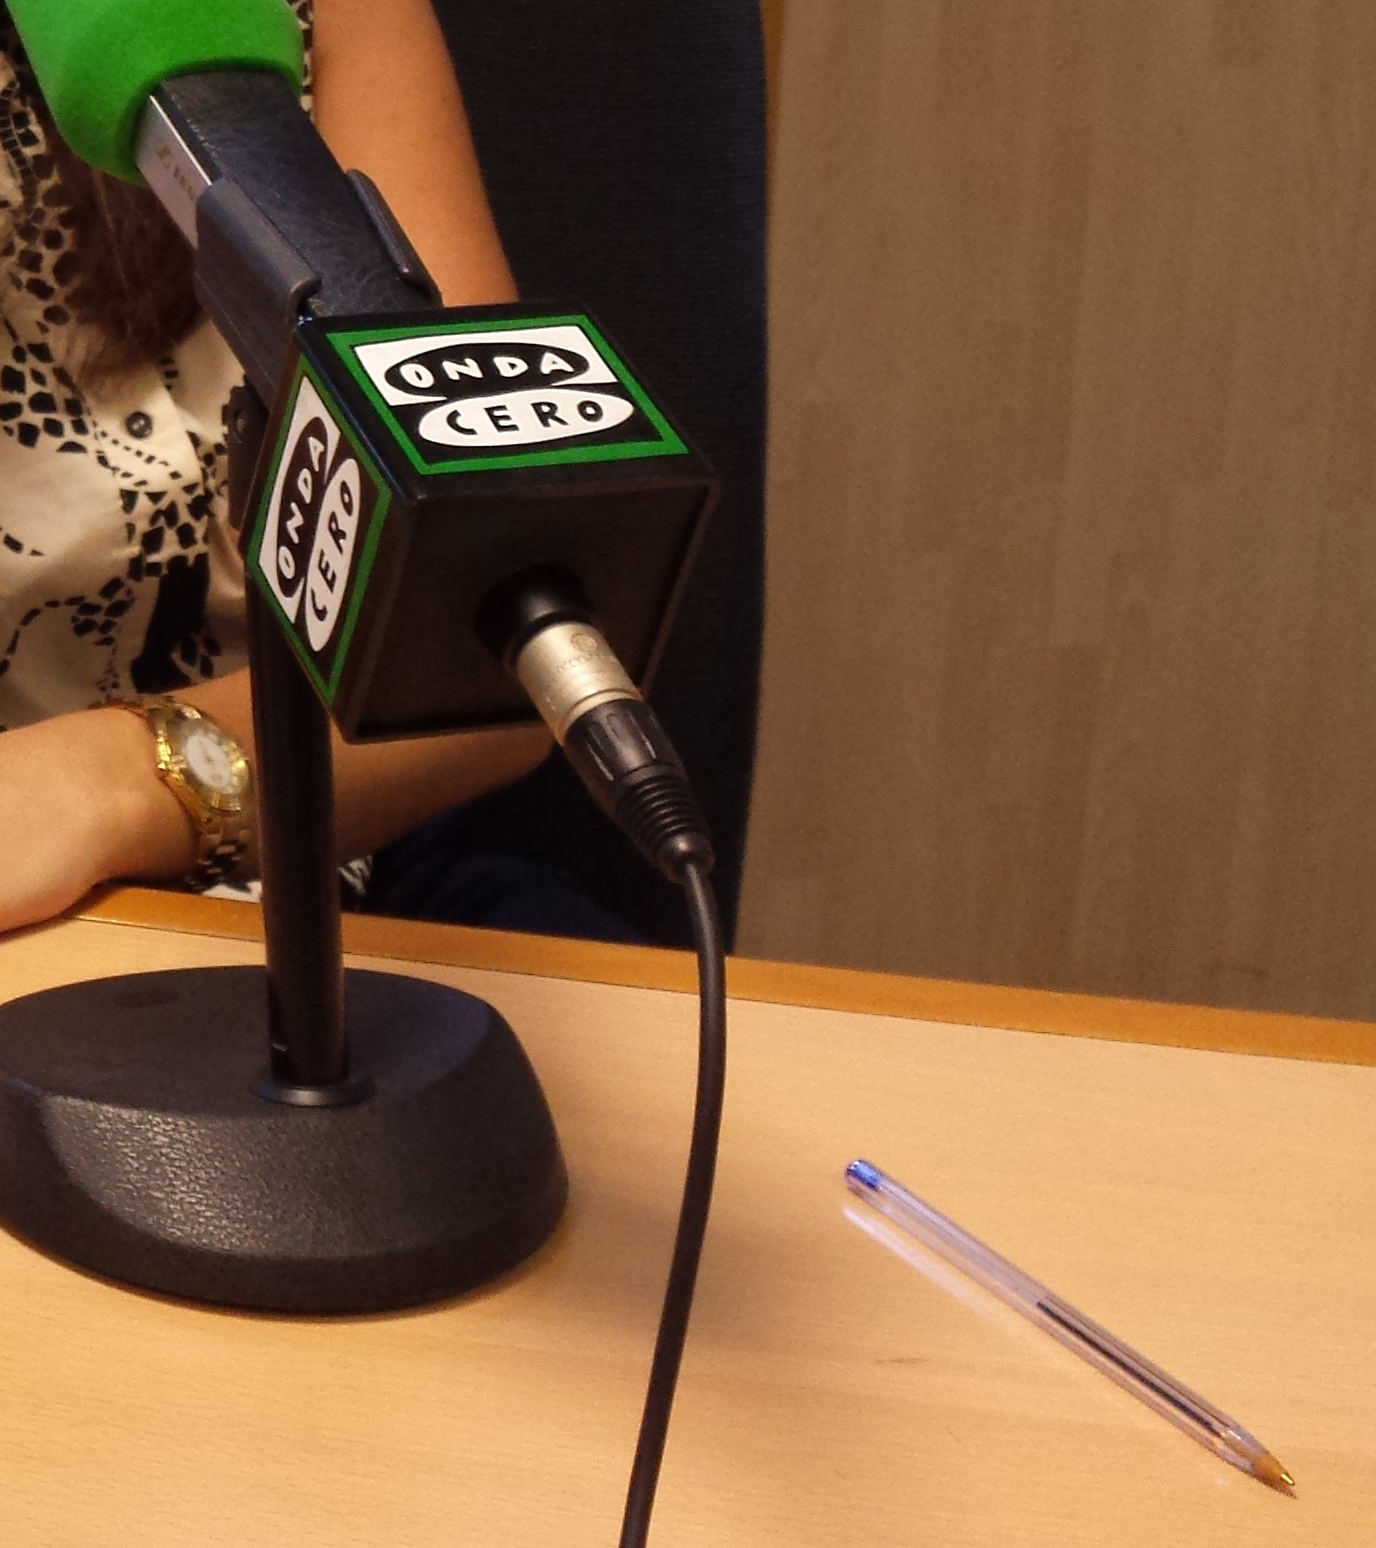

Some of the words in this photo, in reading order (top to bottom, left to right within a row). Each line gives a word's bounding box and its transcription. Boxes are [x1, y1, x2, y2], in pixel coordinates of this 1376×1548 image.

[400, 352, 574, 388] ONDA
[446, 400, 605, 436] CERO
[276, 436, 325, 580] ONDA
[312, 480, 355, 623] CERO
